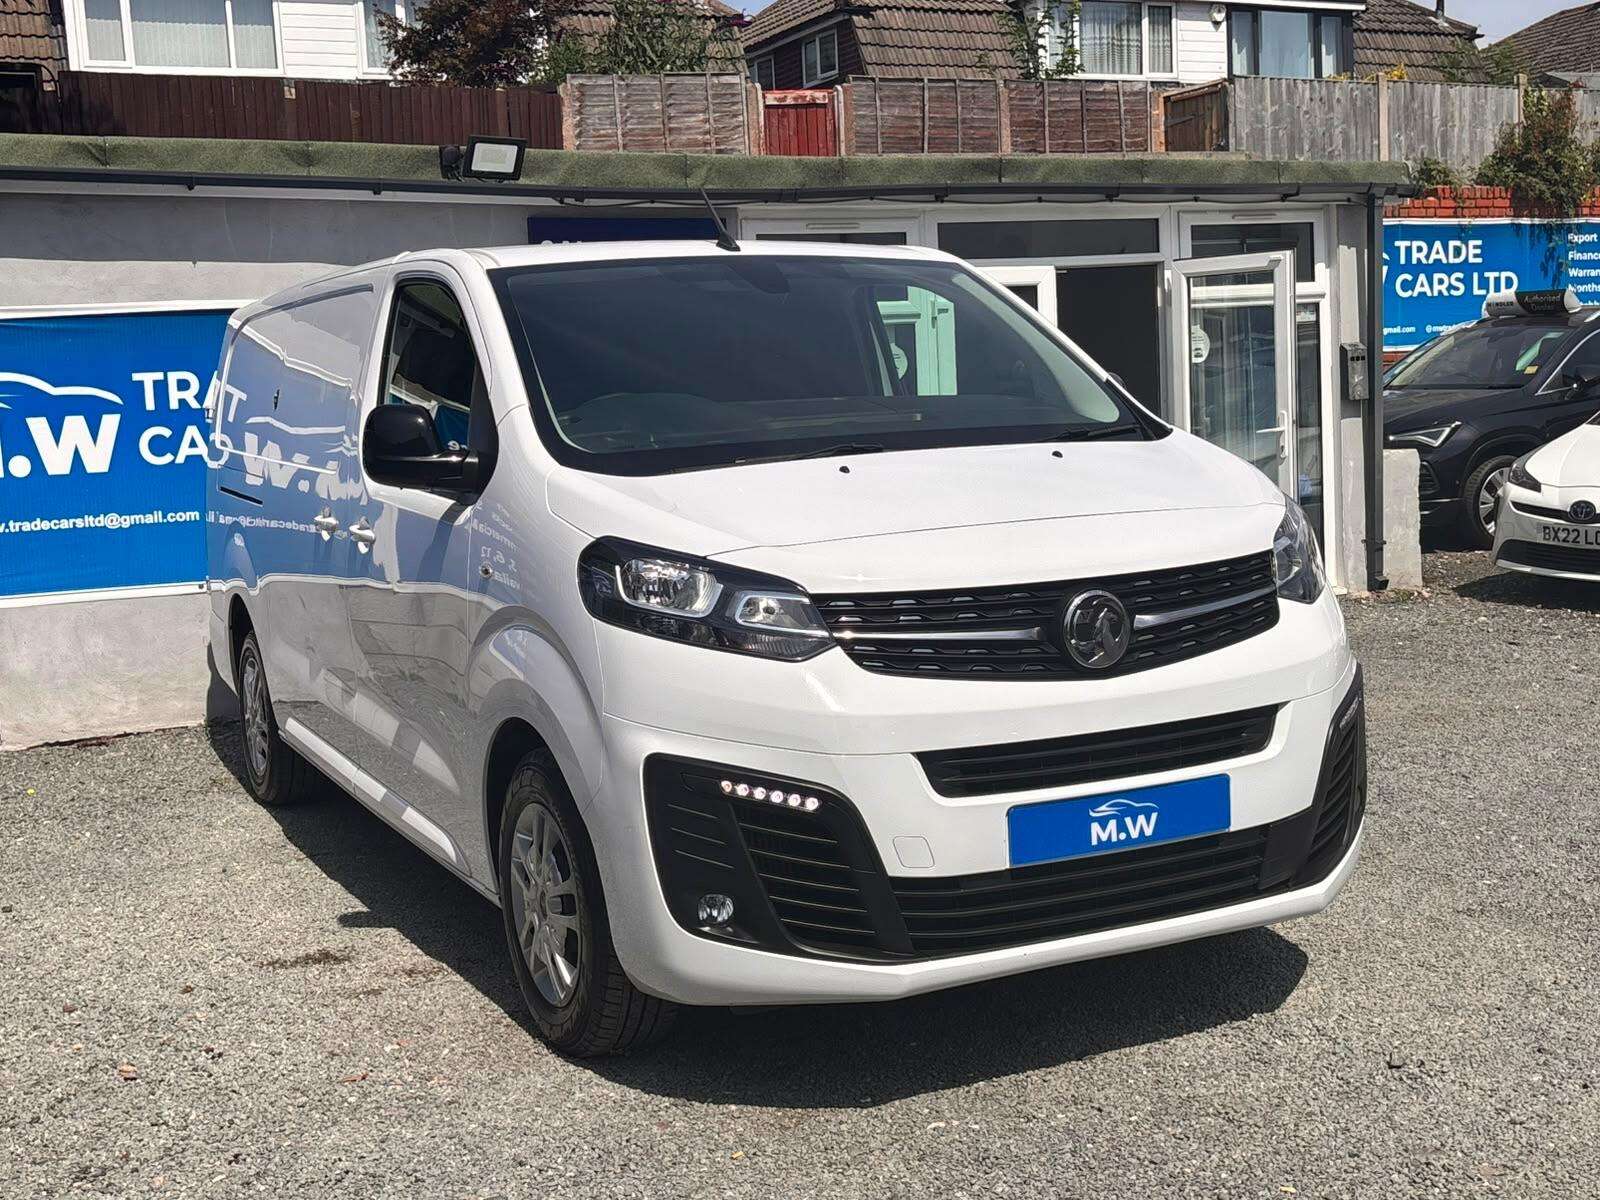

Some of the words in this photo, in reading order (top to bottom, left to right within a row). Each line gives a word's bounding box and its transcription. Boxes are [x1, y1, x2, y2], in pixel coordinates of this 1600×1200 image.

[1568, 233, 1598, 244] Export
[1394, 240, 1483, 264] TRADE
[1568, 250, 1600, 260] Financ
[1395, 272, 1465, 297] CARS
[1472, 271, 1518, 296] LTD
[0, 413, 121, 478] .W
[1542, 526, 1580, 544] BX22
[1090, 812, 1159, 846] M.W
